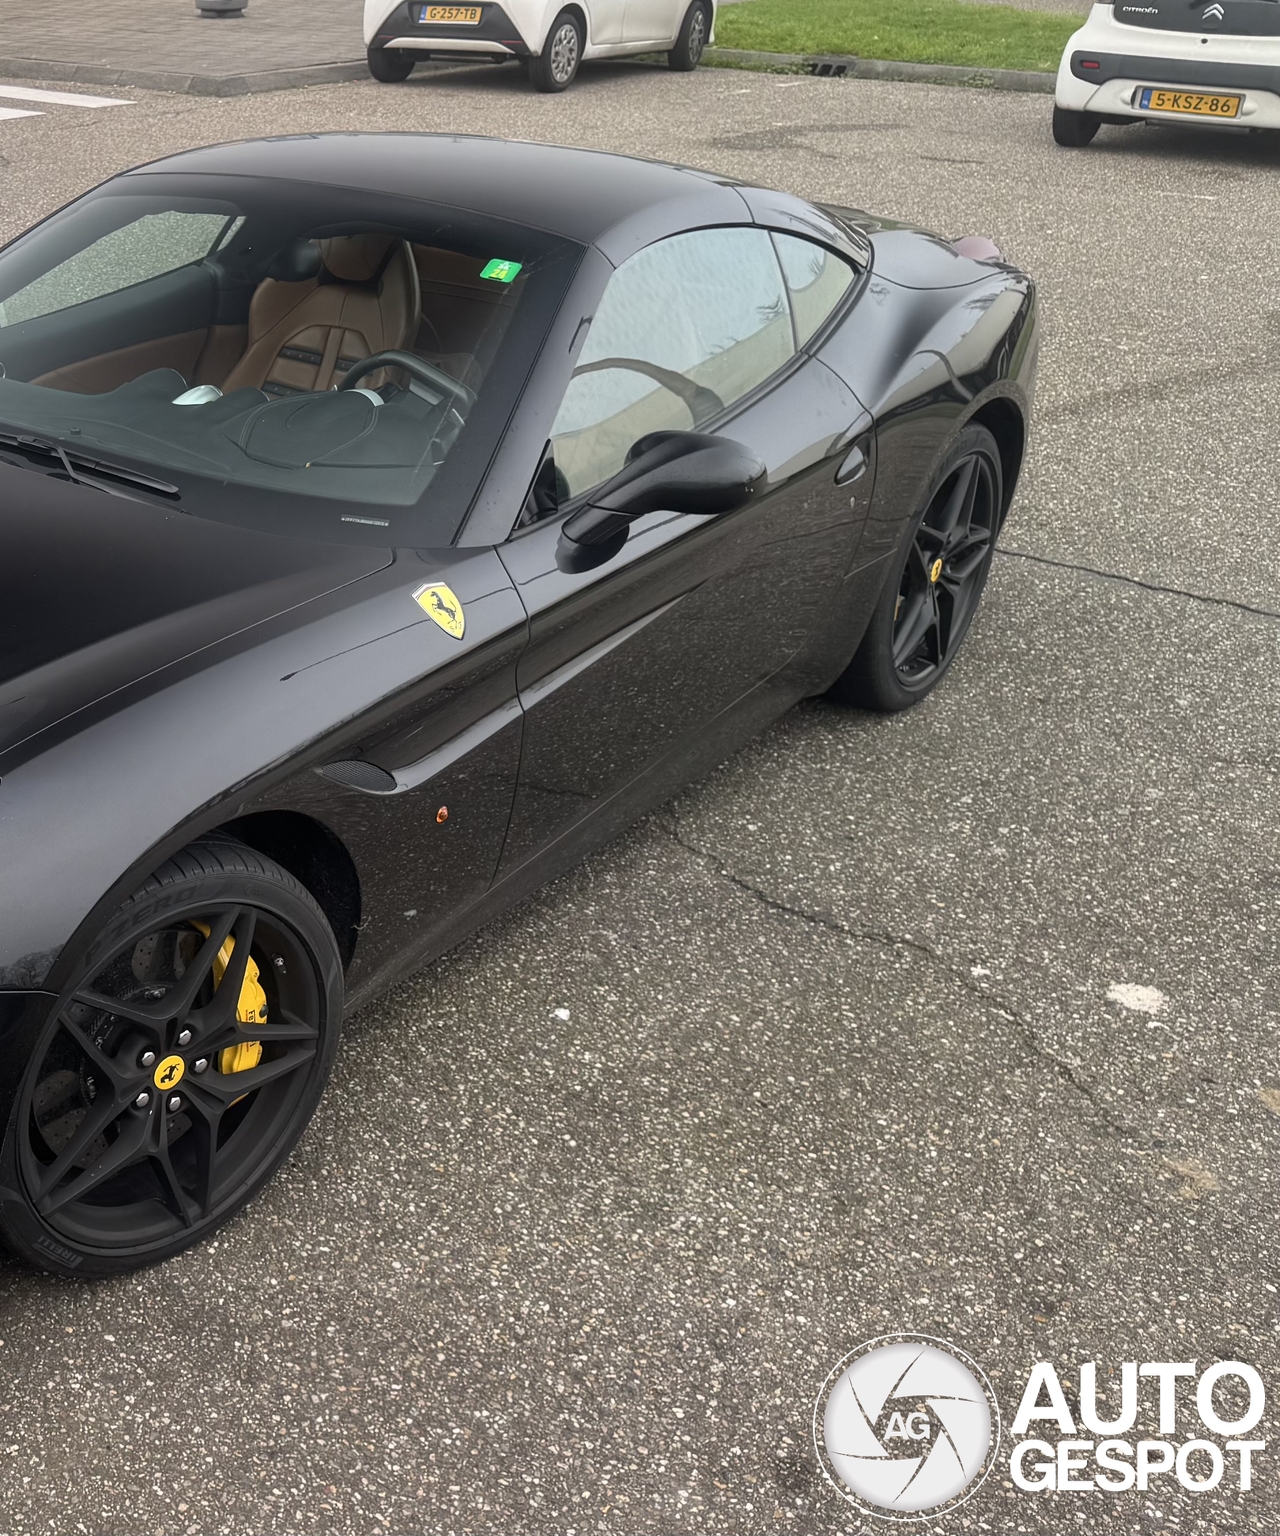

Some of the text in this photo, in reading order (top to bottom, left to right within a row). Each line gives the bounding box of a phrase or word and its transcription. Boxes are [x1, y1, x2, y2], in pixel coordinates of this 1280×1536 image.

[430, 7, 477, 20] G-257-TB
[1155, 92, 1231, 113] 5-KSZ-86
[31, 1235, 84, 1269] PIRELLI
